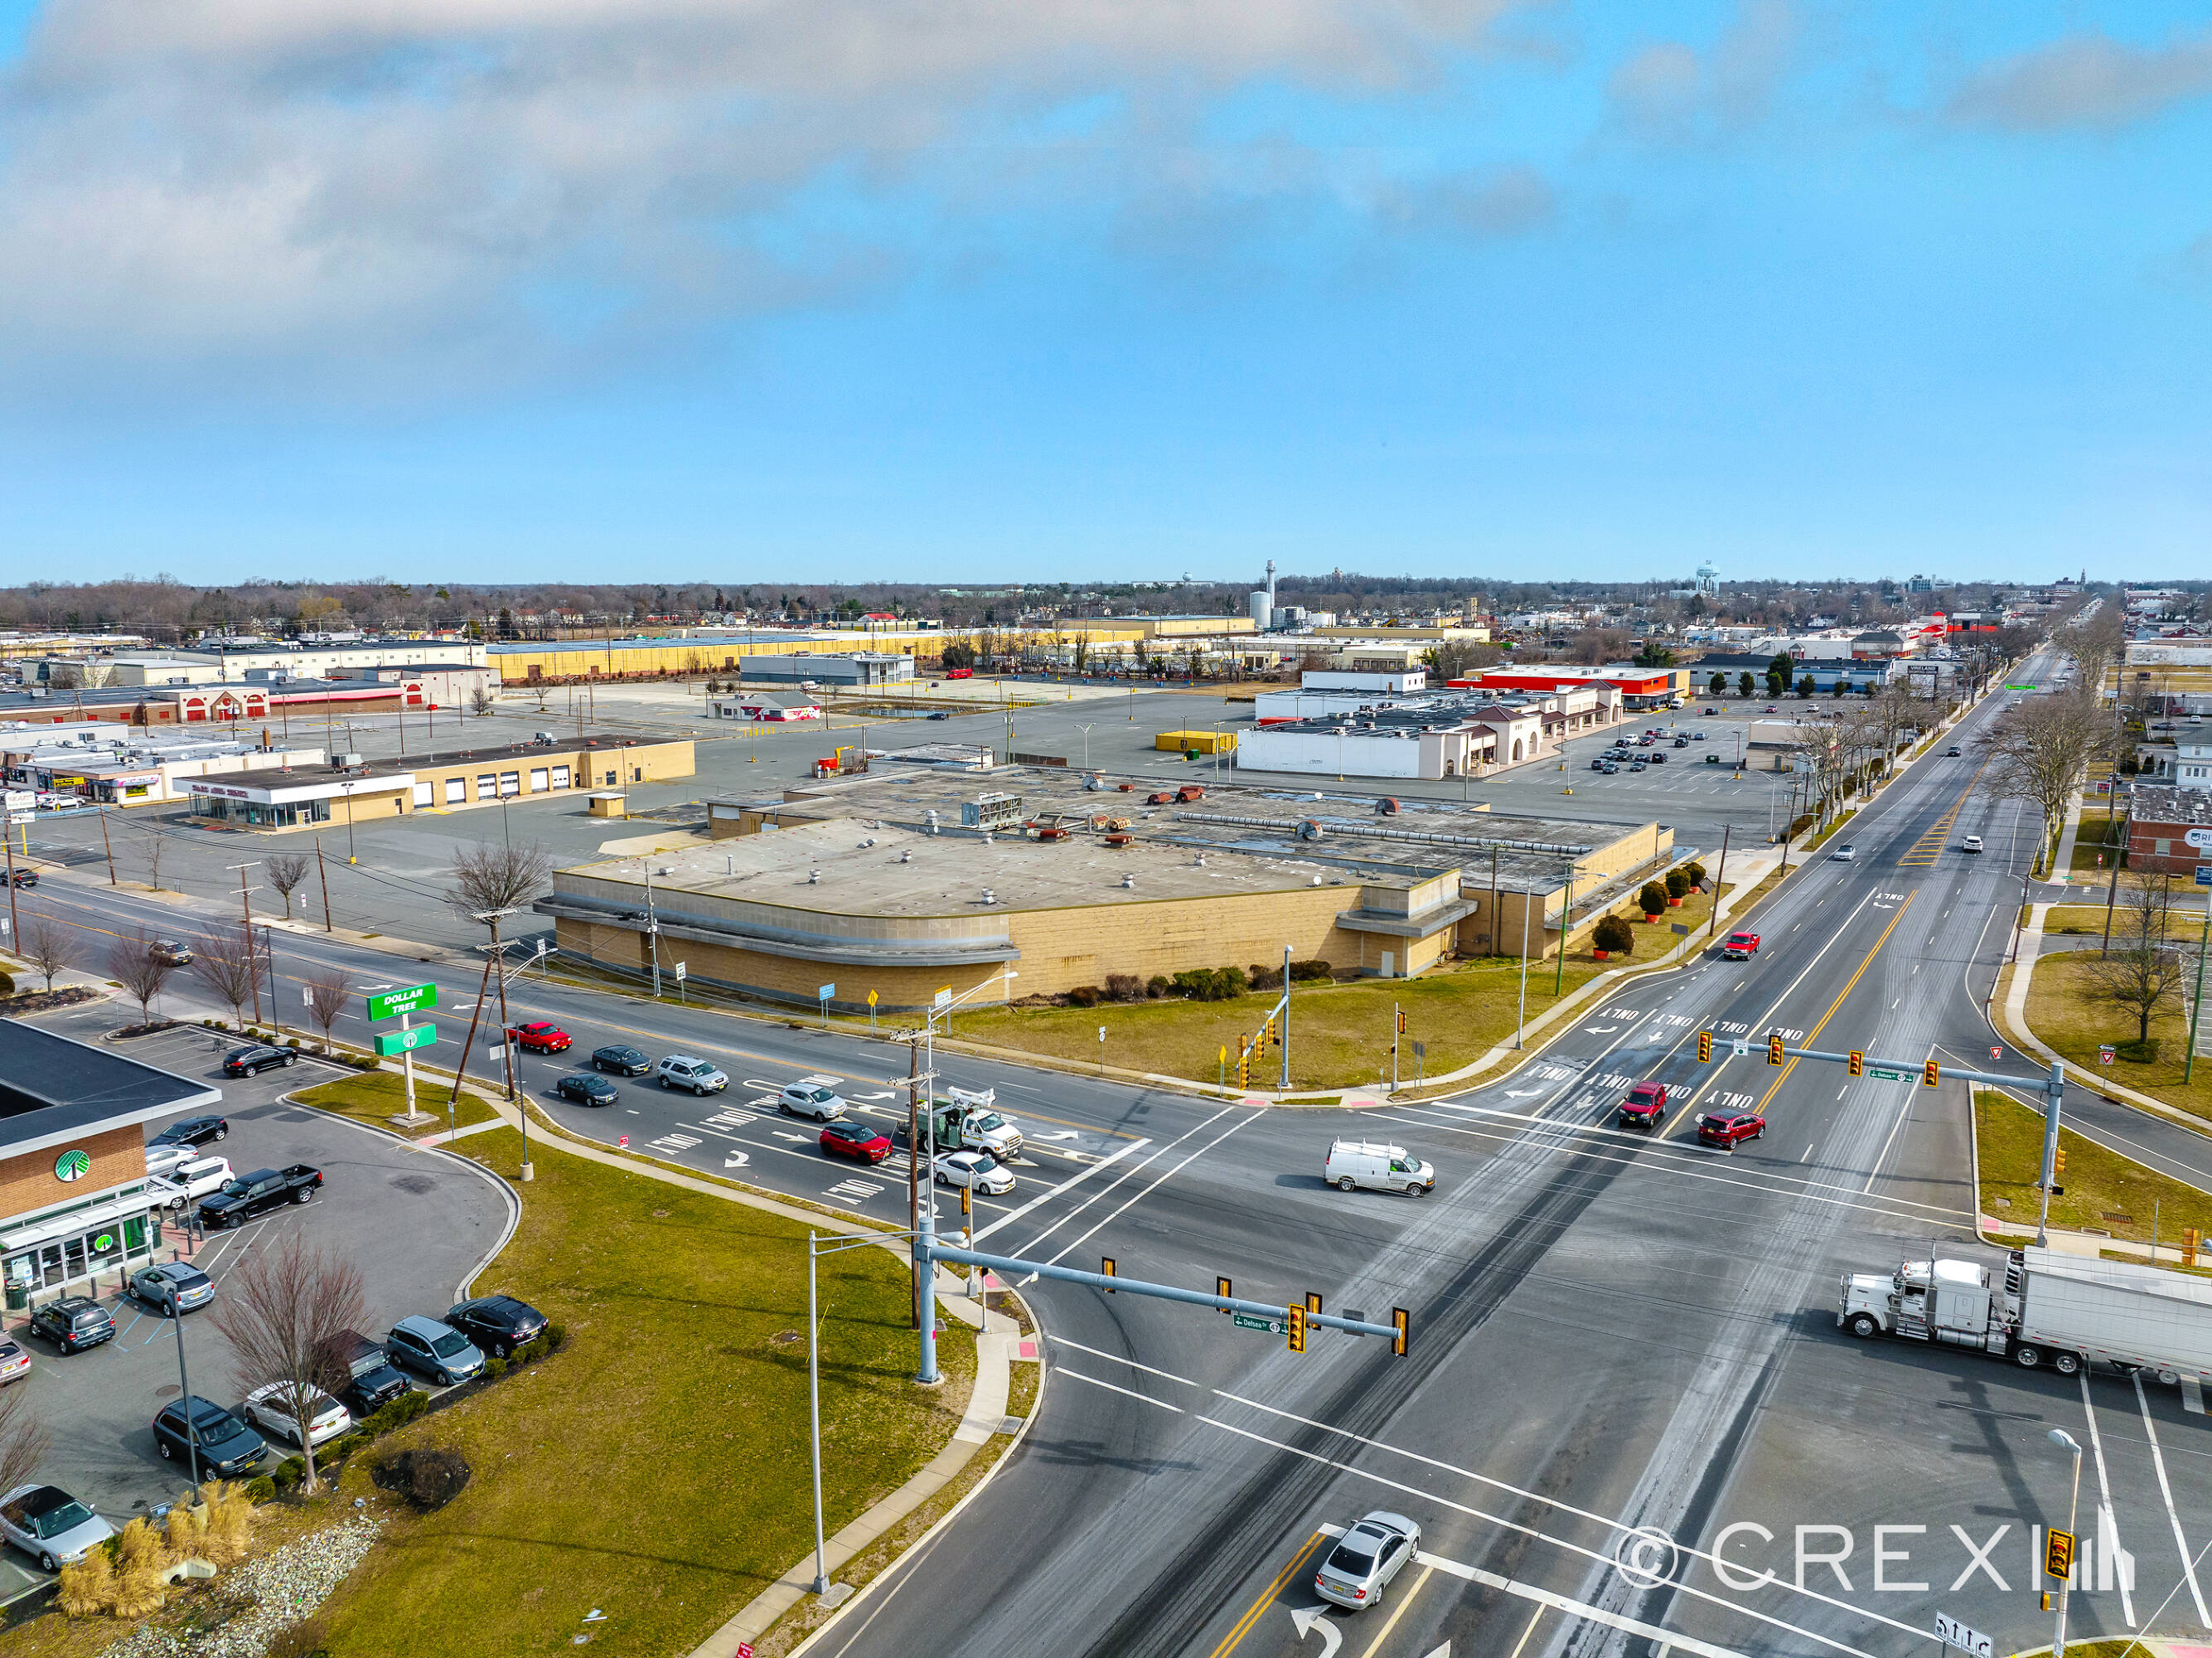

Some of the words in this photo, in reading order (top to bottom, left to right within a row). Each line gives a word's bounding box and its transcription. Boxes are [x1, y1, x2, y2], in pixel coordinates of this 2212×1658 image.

[1875, 893, 1904, 901] ONLY
[384, 988, 424, 1006] DOLLAR
[392, 1001, 417, 1014] TREE
[1598, 1007, 1639, 1020] ONLY
[1652, 1014, 1694, 1027] ONLY
[1706, 1020, 1749, 1034] ONLY
[1761, 1026, 1804, 1040] ONLY
[1523, 1065, 1571, 1081] ONLY
[1584, 1073, 1632, 1090] ONLY
[1663, 1083, 1692, 1099] ONL
[1705, 1089, 1754, 1108] ONLY
[699, 1111, 758, 1132] ONLY
[644, 1133, 703, 1156] ONLY
[820, 1179, 885, 1206] ONLY
[1243, 1319, 1262, 1329] Delsea
